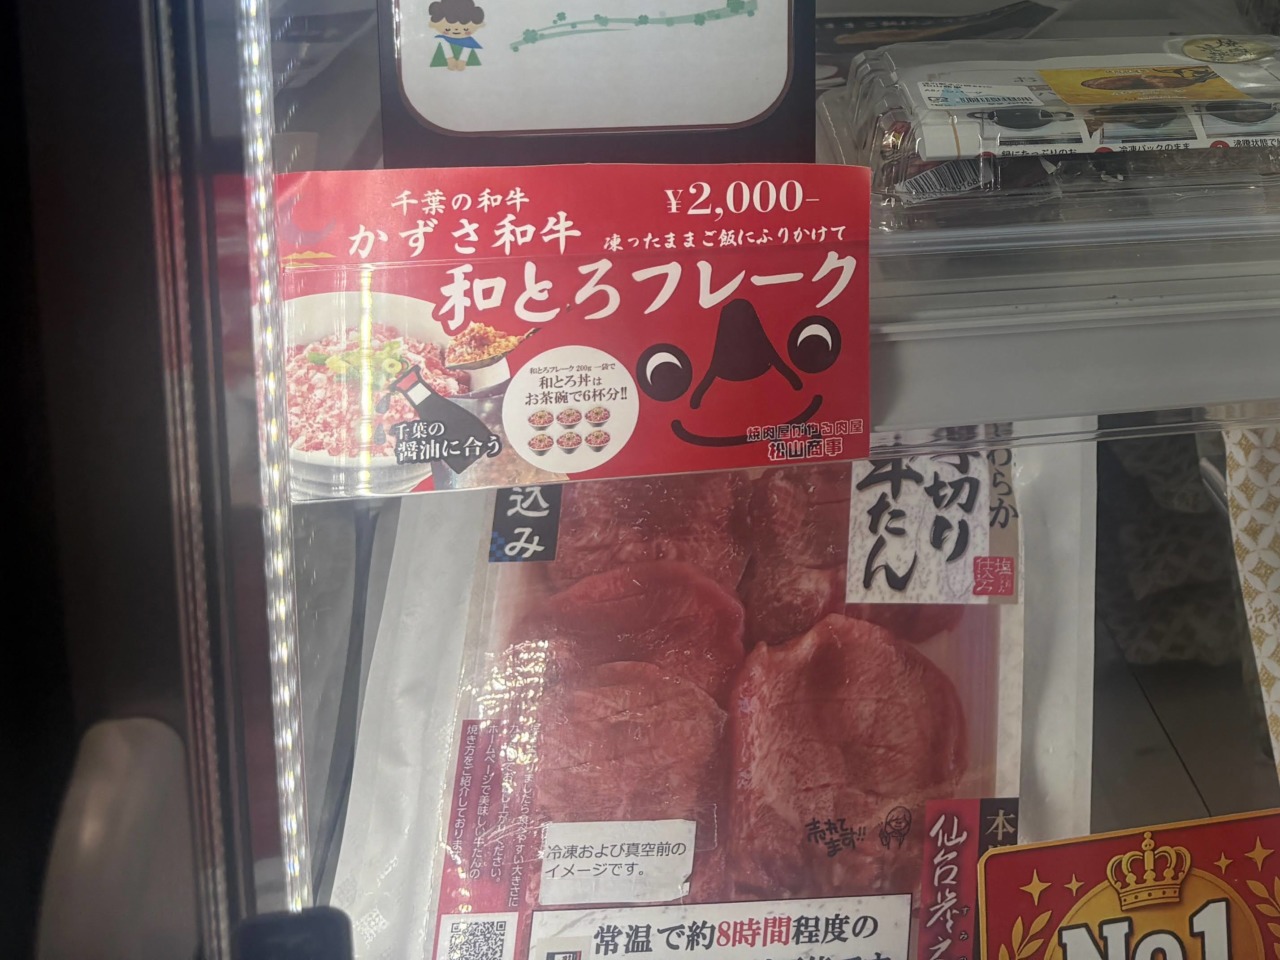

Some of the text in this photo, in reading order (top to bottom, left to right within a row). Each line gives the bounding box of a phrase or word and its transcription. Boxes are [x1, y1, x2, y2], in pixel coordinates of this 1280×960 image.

[391, 188, 531, 215] 千葉の和牛
[347, 210, 583, 258] かずさ和牛
[602, 224, 847, 253] 凍ったままご飯にふりかけて
[437, 250, 859, 330] 和とろフレーク
[538, 373, 603, 390] 和とろ丼は
[524, 386, 628, 406] お茶碗で6杯分!!
[396, 421, 445, 440] 千葉の
[746, 418, 864, 442] 焼肉屋がやる肉屋
[397, 435, 500, 462] 醤油に合う
[767, 436, 843, 461] 松山商事
[546, 840, 686, 861] 冷凍および真空前の
[544, 861, 646, 879] イメージです。
[592, 913, 880, 956] 常温で約8時間程度の
